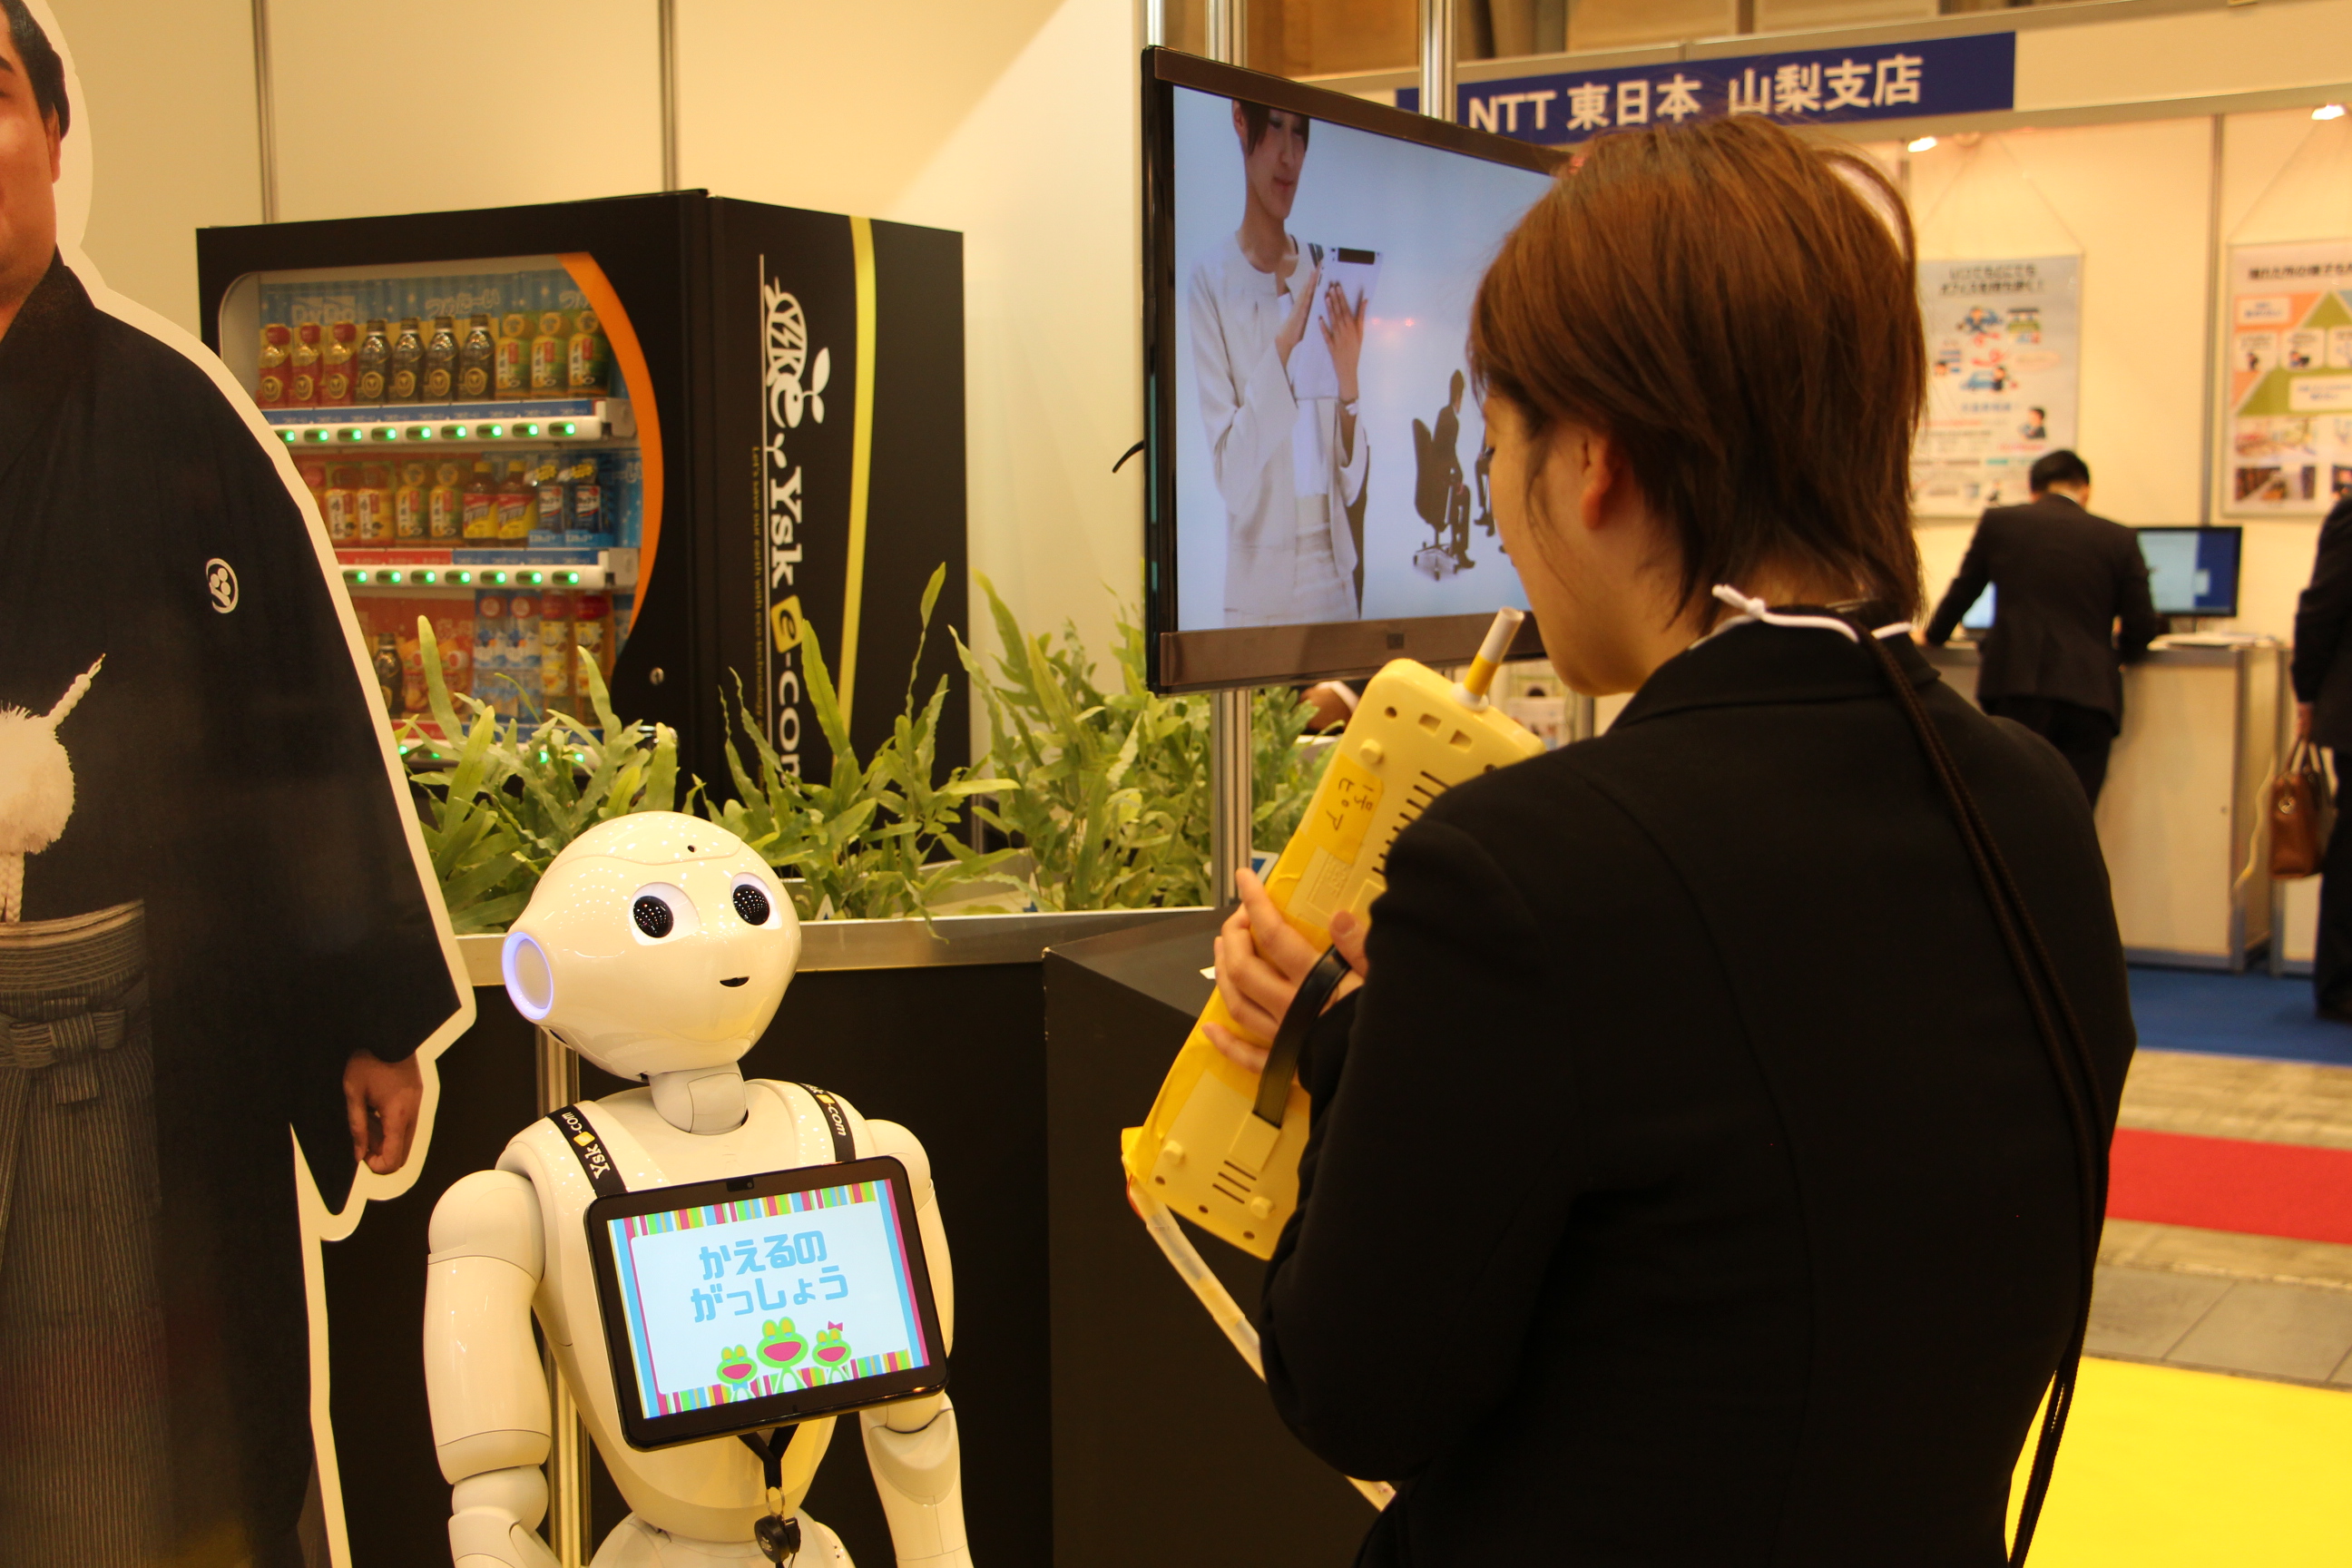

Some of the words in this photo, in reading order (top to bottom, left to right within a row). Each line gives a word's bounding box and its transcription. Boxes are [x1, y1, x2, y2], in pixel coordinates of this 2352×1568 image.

[1468, 91, 1556, 134] NTT
[1566, 74, 1701, 131] 東日本
[1728, 54, 1924, 115] 山梨支店
[770, 466, 803, 590] Ysk
[699, 1230, 828, 1281] かえるの
[690, 1264, 849, 1323] がっしょう
